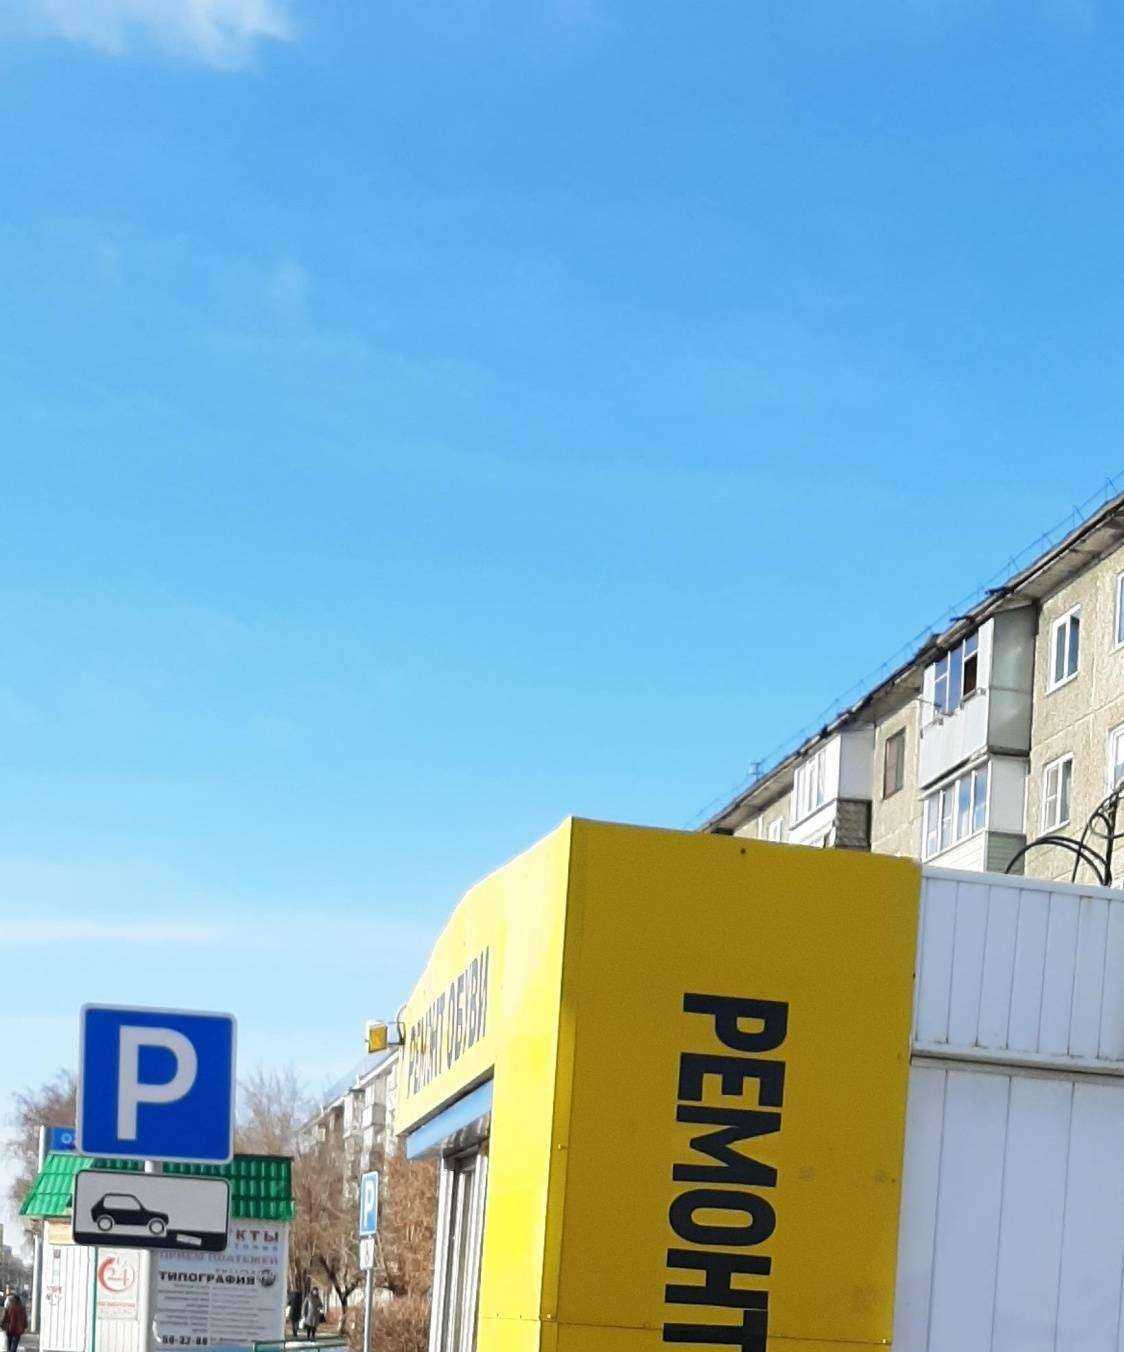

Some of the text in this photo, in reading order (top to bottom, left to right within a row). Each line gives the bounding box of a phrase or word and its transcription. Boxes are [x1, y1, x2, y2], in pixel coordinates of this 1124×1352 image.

[447, 945, 489, 1068] ОБУВИ
[117, 1025, 198, 1141] P
[159, 1270, 255, 1285] ТИПОГРАФИЯ
